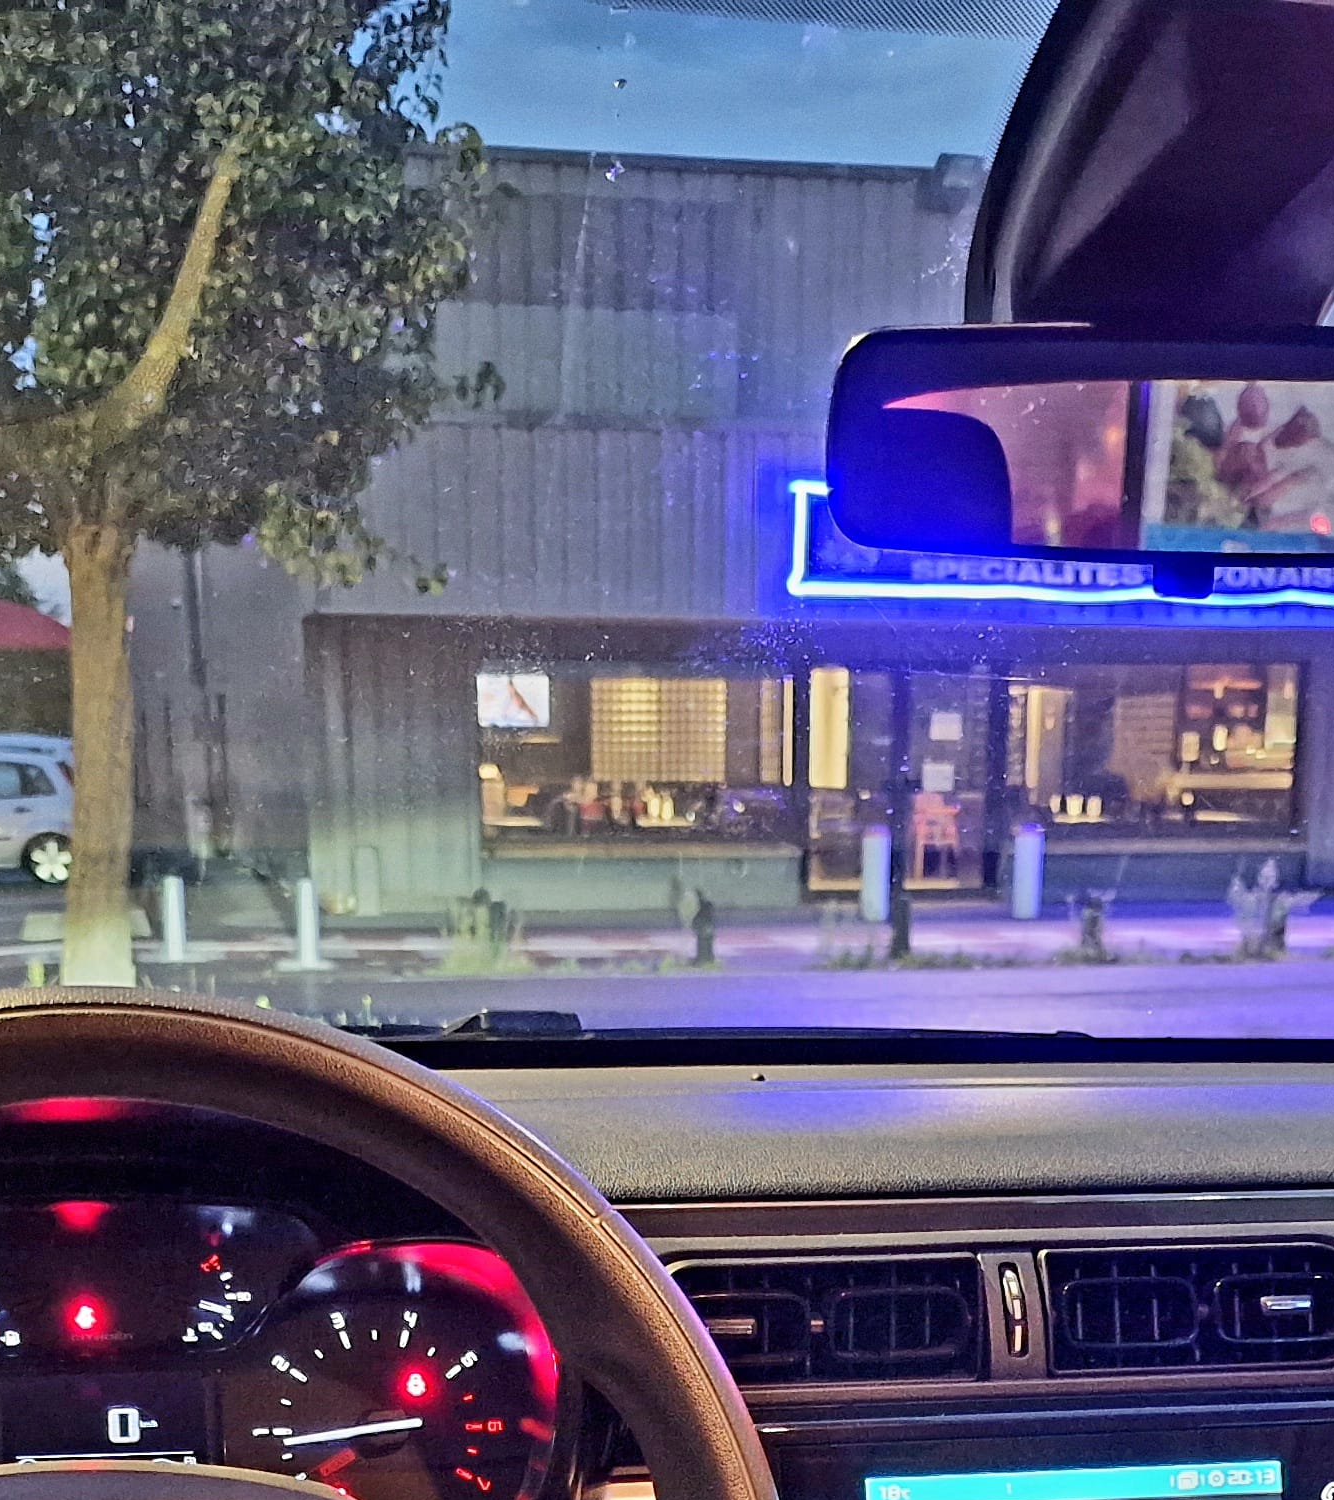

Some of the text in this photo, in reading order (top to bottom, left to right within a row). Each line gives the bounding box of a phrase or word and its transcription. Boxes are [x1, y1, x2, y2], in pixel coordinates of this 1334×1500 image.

[329, 1310, 347, 1330] 3
[402, 1310, 418, 1329] 4
[270, 1354, 291, 1372] 2
[459, 1350, 479, 1368] 5
[107, 1407, 141, 1444] 0
[487, 1420, 504, 1432] 6
[476, 1476, 491, 1491] 7
